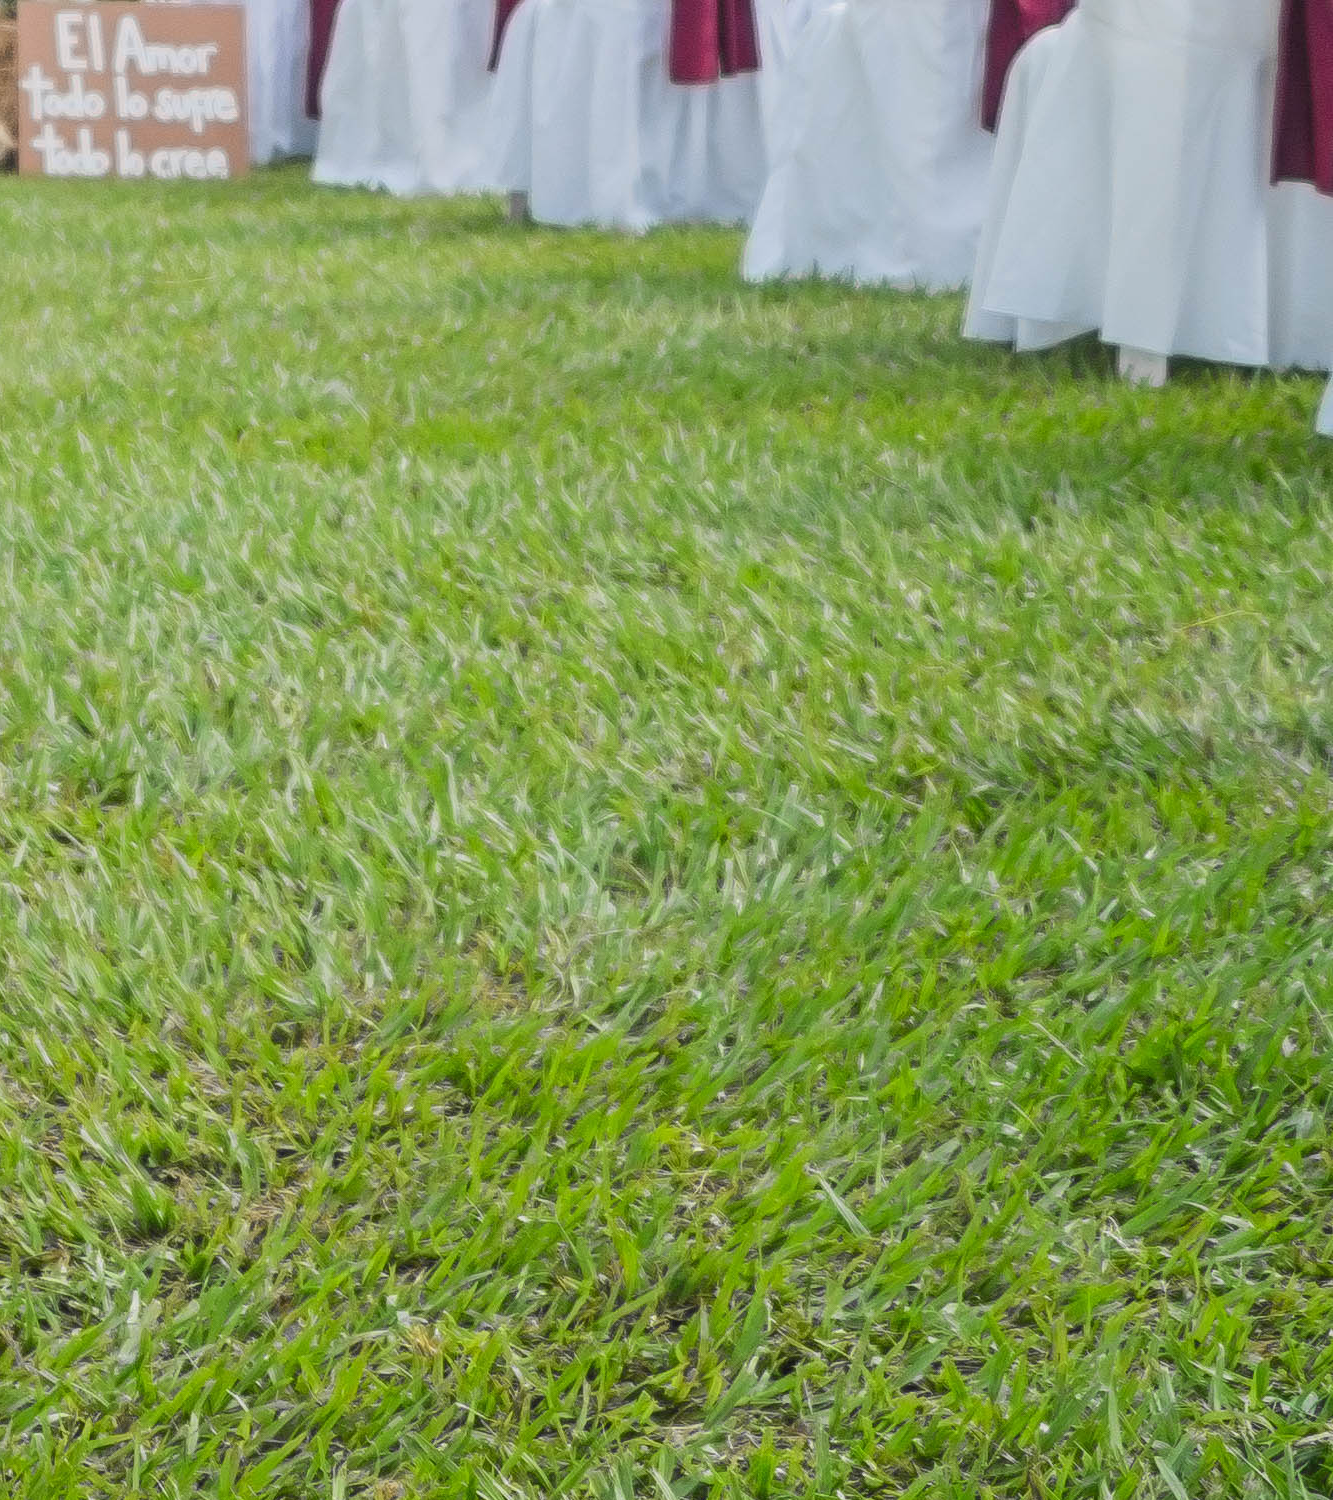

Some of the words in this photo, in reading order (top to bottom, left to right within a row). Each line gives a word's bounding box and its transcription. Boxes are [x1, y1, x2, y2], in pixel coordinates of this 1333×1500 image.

[56, 11, 103, 73] El
[114, 15, 217, 75] Amor
[22, 65, 105, 121] todo
[115, 74, 148, 120] lo
[32, 123, 110, 178] todo
[116, 128, 145, 179] lo
[150, 150, 230, 180] cree
